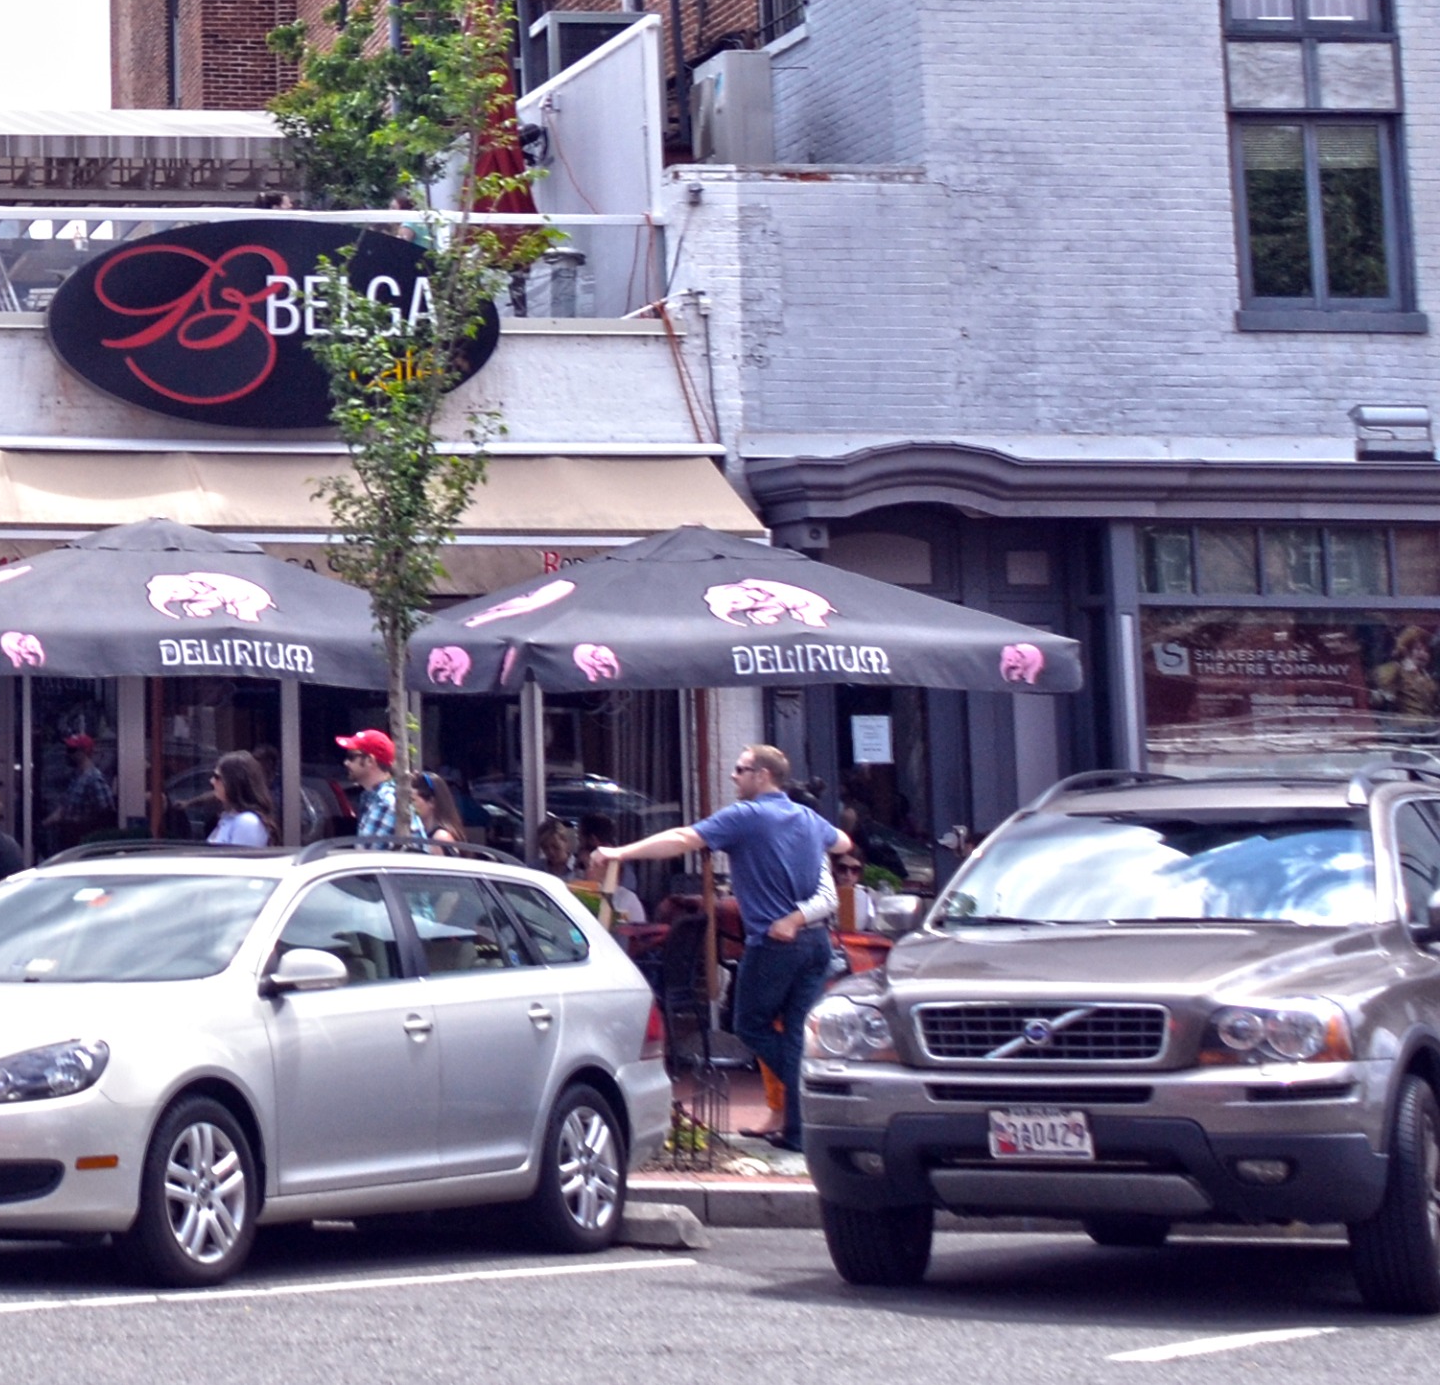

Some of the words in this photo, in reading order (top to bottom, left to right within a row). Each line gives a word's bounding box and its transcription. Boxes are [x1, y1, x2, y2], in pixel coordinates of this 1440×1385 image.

[266, 274, 440, 338] BELGA
[158, 639, 315, 673] DELIRIUM
[731, 644, 891, 675] DELIRIUM
[1193, 648, 1310, 663] SHAKESPEARE
[1196, 663, 1266, 675] THEATRE
[1270, 663, 1351, 677] COMPANY
